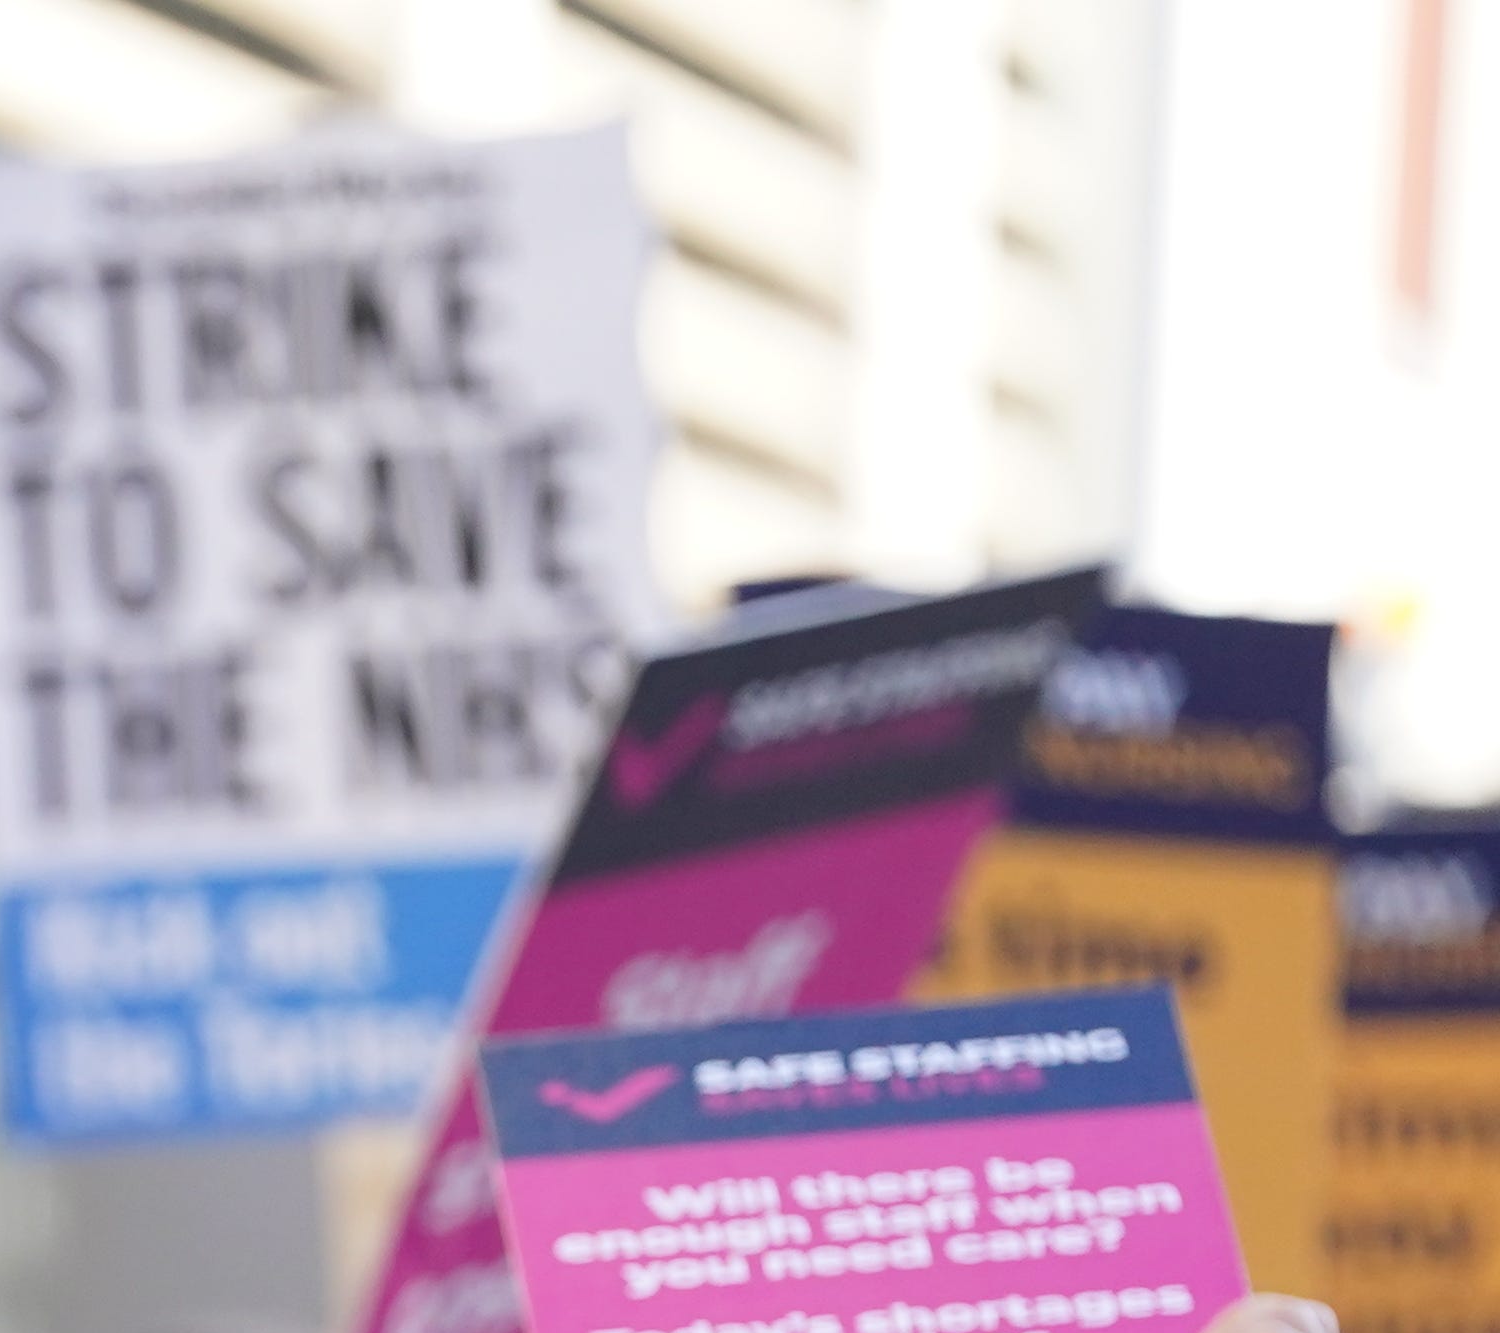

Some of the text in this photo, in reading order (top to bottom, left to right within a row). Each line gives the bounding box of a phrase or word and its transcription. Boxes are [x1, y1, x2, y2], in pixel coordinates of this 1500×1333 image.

[8, 425, 580, 617] TO SAVE
[22, 644, 265, 819] THE
[694, 1029, 1130, 1096] SAFE STAFFING
[553, 1181, 1183, 1264] enough staff when
[642, 1157, 1074, 1221] Will there be
[622, 1216, 1125, 1300] you need care?
